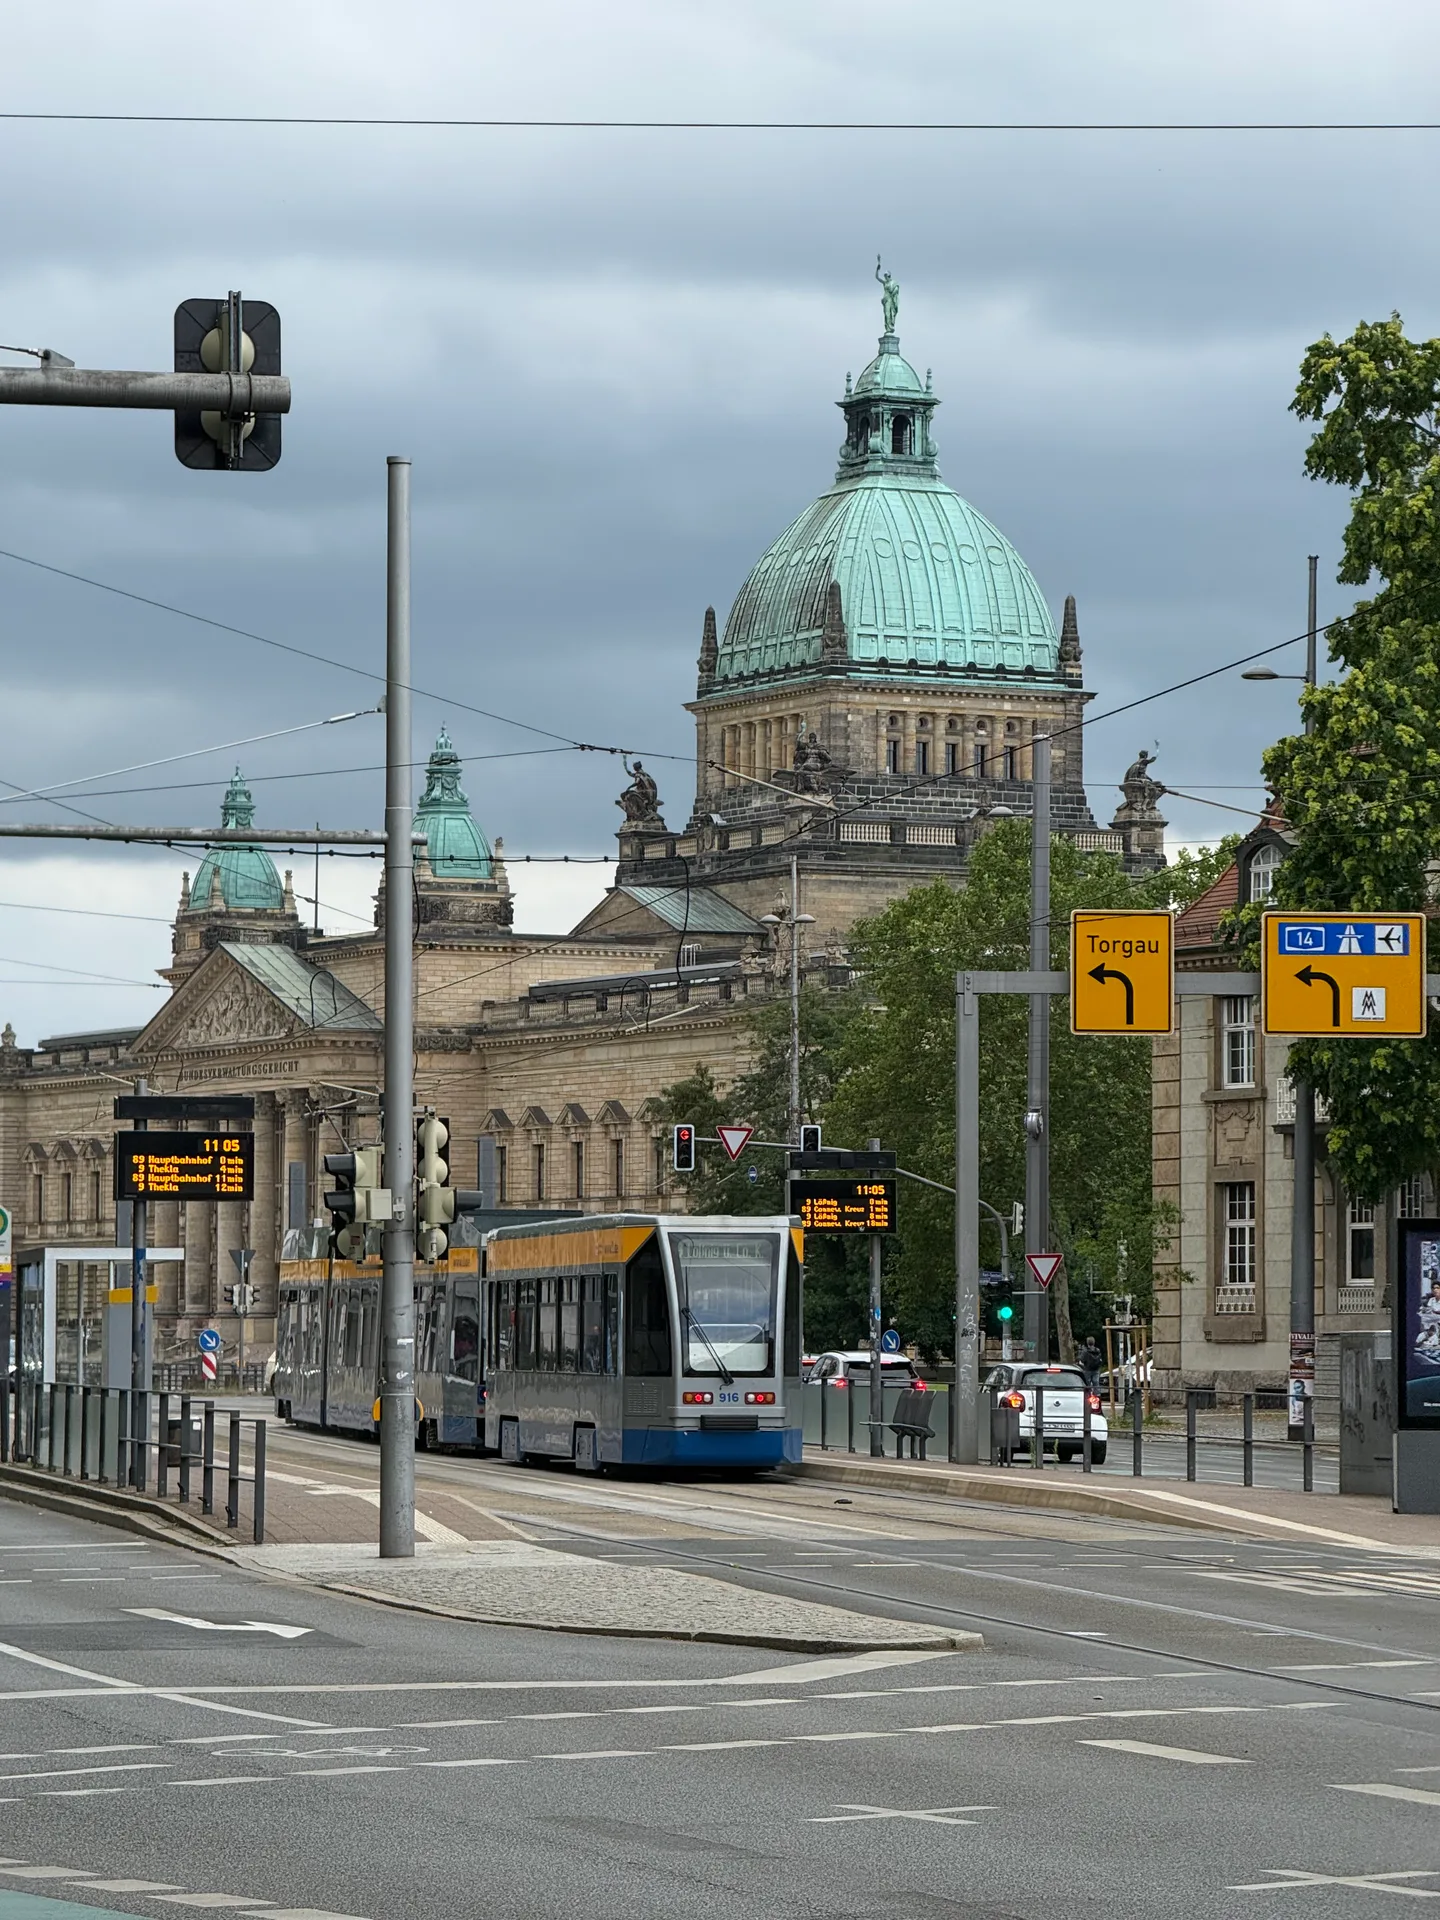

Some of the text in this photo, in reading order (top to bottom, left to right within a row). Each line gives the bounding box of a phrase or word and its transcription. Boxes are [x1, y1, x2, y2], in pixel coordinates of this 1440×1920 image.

[1296, 931, 1314, 946] 14
[1087, 935, 1160, 958] Torgau
[180, 1061, 299, 1081] BUNDESVERWALTUNGSGERICHT
[132, 1155, 145, 1164] 89
[148, 1155, 213, 1167] Hauptbahnhof
[138, 1164, 145, 1173] 9
[148, 1164, 179, 1173] Thekla
[132, 1173, 145, 1182] 89
[148, 1173, 213, 1185] Hauptbahnhof
[138, 1183, 145, 1192] 9
[148, 1183, 179, 1192] Thekla
[856, 1185, 885, 1195] 11:05
[806, 1198, 812, 1206] 9
[719, 1392, 739, 1402] 916
